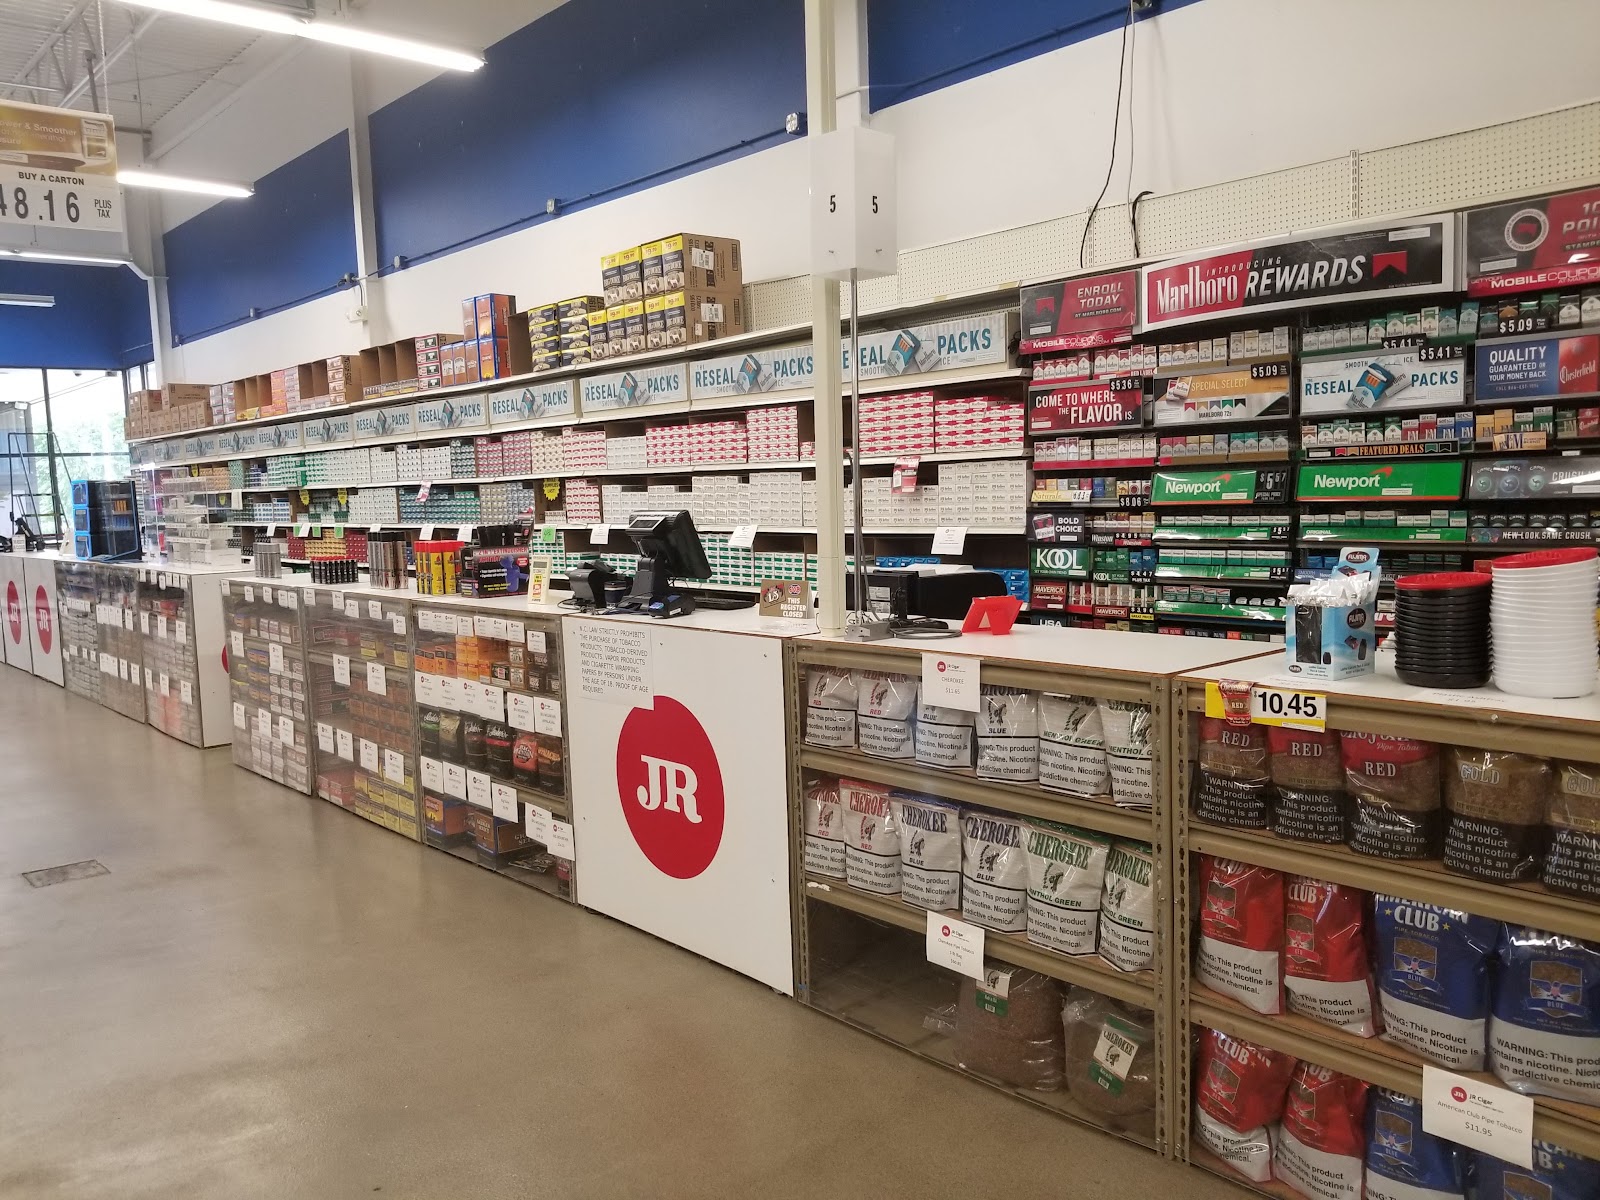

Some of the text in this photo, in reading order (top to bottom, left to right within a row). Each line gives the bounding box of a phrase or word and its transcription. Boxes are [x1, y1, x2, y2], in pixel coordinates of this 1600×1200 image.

[34, 123, 77, 136] Smoother
[18, 172, 37, 180] BUY
[49, 175, 85, 185] CARTON
[95, 199, 112, 209] PLUS
[830, 195, 836, 213] 5
[873, 196, 878, 214] 5
[97, 209, 110, 218] TAX
[1206, 257, 1281, 277] INTRODUCING
[1077, 282, 1124, 298] ENROLL
[1155, 254, 1366, 316] Marlboro REWARDS
[1080, 294, 1120, 309] TODAY
[1421, 346, 1450, 360] $5.41
[1490, 346, 1546, 365] QUALITY
[695, 356, 813, 388] RESEAL PACKS
[1345, 361, 1369, 369] SMOOTH
[1489, 362, 1536, 373] GUARANTEED
[1560, 360, 1595, 384] Chesterfield
[1305, 370, 1458, 396] RESEAL PACKS
[1507, 372, 1527, 380] MONEY
[585, 375, 679, 403] RESEAL PACKS
[1191, 378, 1248, 392] SPECIAL SELECT
[492, 390, 568, 415] RESEAL PACKS
[1036, 388, 1116, 408] COME TO WHERE
[356, 411, 410, 430] RESEAL PACKS
[418, 403, 481, 423] RESEAL PACKS
[1058, 406, 1069, 415] THE
[1070, 404, 1123, 424] FLAVOR
[1199, 411, 1223, 419] MARLBORO
[306, 422, 349, 437] RESEAL PACKS
[1360, 443, 1424, 455] FEATURED DEALS
[1165, 480, 1221, 495] Newport
[1314, 474, 1380, 491] Newport
[1036, 548, 1082, 569] KOOL
[10, 603, 20, 624] JR
[38, 608, 49, 632] JR
[589, 635, 610, 643] PURCHASE
[619, 639, 640, 647] TOBACCO
[620, 630, 645, 638] PROHIBITS
[605, 646, 648, 656] TOBACCO-DERIVED
[591, 661, 613, 670] CIGARETTE
[615, 664, 639, 673] WRAPPING
[621, 656, 645, 665] PRODUCTS
[605, 672, 624, 680] PERSONS
[1258, 691, 1317, 717] 10.45
[1221, 730, 1250, 747] RED
[1291, 742, 1323, 757] RED
[1365, 761, 1396, 777] RED
[1460, 764, 1500, 785] GOLD
[637, 754, 703, 824] JR
[902, 804, 947, 833] CHEROKEE
[1453, 817, 1503, 836] WARNING:
[1449, 827, 1508, 848] This product
[1028, 830, 1093, 870] CHEROKEE
[1445, 846, 1508, 869] Nicotine is an
[1475, 844, 1520, 859] nicotine.
[909, 858, 924, 866] BLUE
[977, 873, 995, 882] BLUE
[1288, 884, 1317, 903] CLUB
[1118, 914, 1144, 927] GREEN
[1394, 906, 1440, 932] CLUB
[1407, 974, 1422, 983] BLUE
[1102, 1030, 1135, 1056] CHEROKEE
[1217, 1034, 1249, 1065] CLUB
[1497, 1037, 1548, 1059] WARNING:
[1550, 1053, 1573, 1064] This
[1512, 1067, 1560, 1083] addictive
[1526, 1059, 1572, 1075] nicotine.
[1477, 1095, 1493, 1106] Cigar
[1437, 1101, 1465, 1115] American
[1466, 1110, 1480, 1119] Club
[1481, 1113, 1495, 1125] Pipe
[1496, 1119, 1523, 1134] Tobacco
[1465, 1122, 1493, 1137] $11.95
